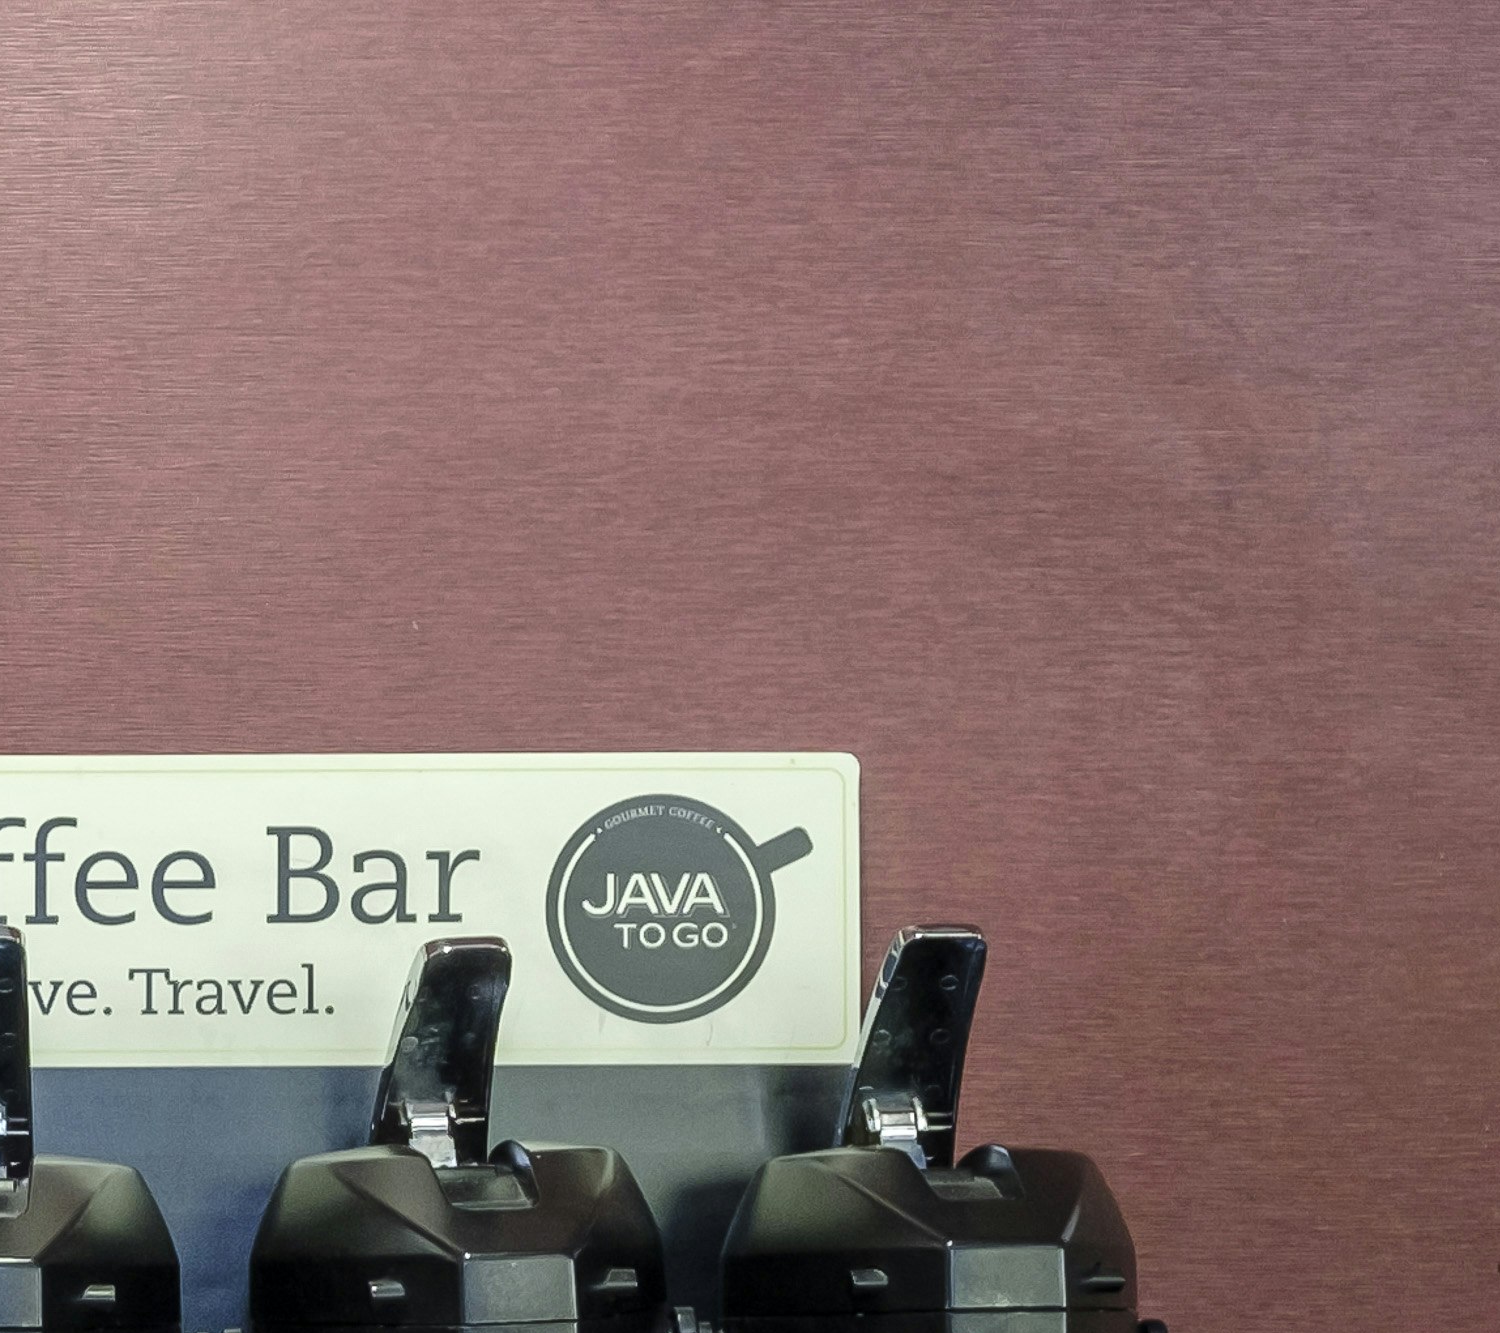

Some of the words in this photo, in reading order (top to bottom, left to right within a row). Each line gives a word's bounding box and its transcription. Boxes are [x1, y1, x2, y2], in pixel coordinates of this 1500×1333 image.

[604, 805, 665, 830] GOURMET
[669, 806, 714, 830] COFFEE
[266, 826, 480, 925] Bar
[582, 872, 727, 915] JAVA
[614, 922, 666, 948] TO
[672, 922, 728, 948] GO
[128, 963, 335, 1016] Travel.
